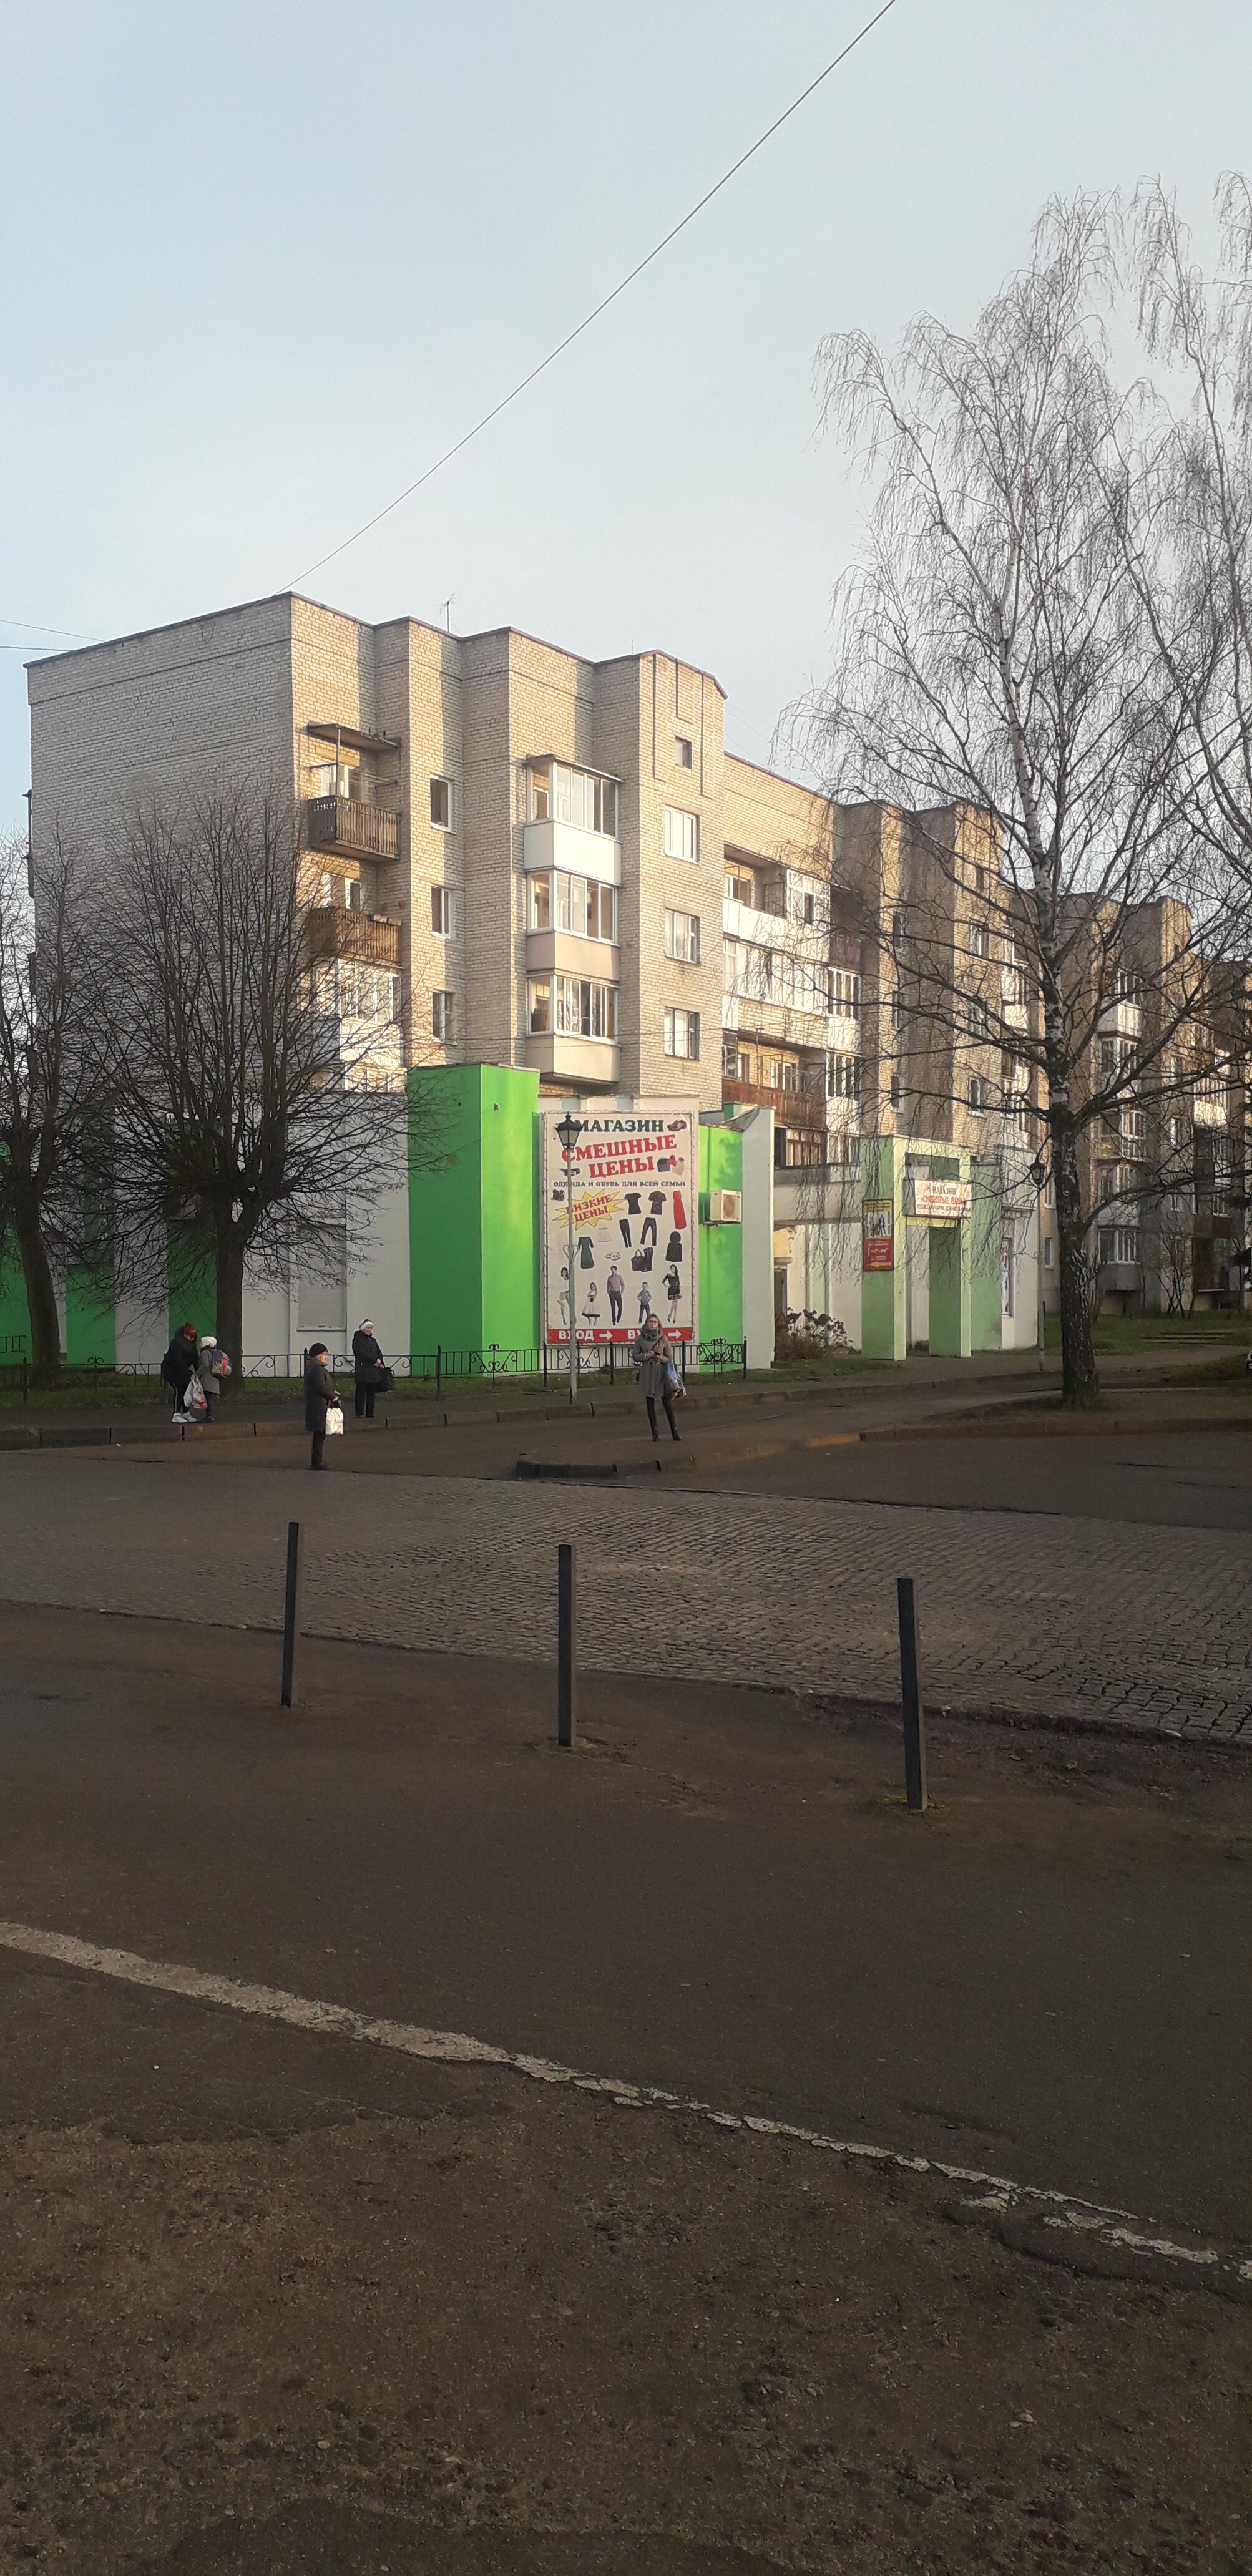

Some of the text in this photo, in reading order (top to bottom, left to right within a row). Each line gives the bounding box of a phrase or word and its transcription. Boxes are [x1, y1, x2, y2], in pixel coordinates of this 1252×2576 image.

[574, 1119, 664, 1133] МАГАЗИН
[561, 1134, 677, 1163] СМЕШНЫЕ
[588, 1156, 655, 1179] ЦЕНЫ
[574, 1206, 609, 1222] ЦЕНЫ
